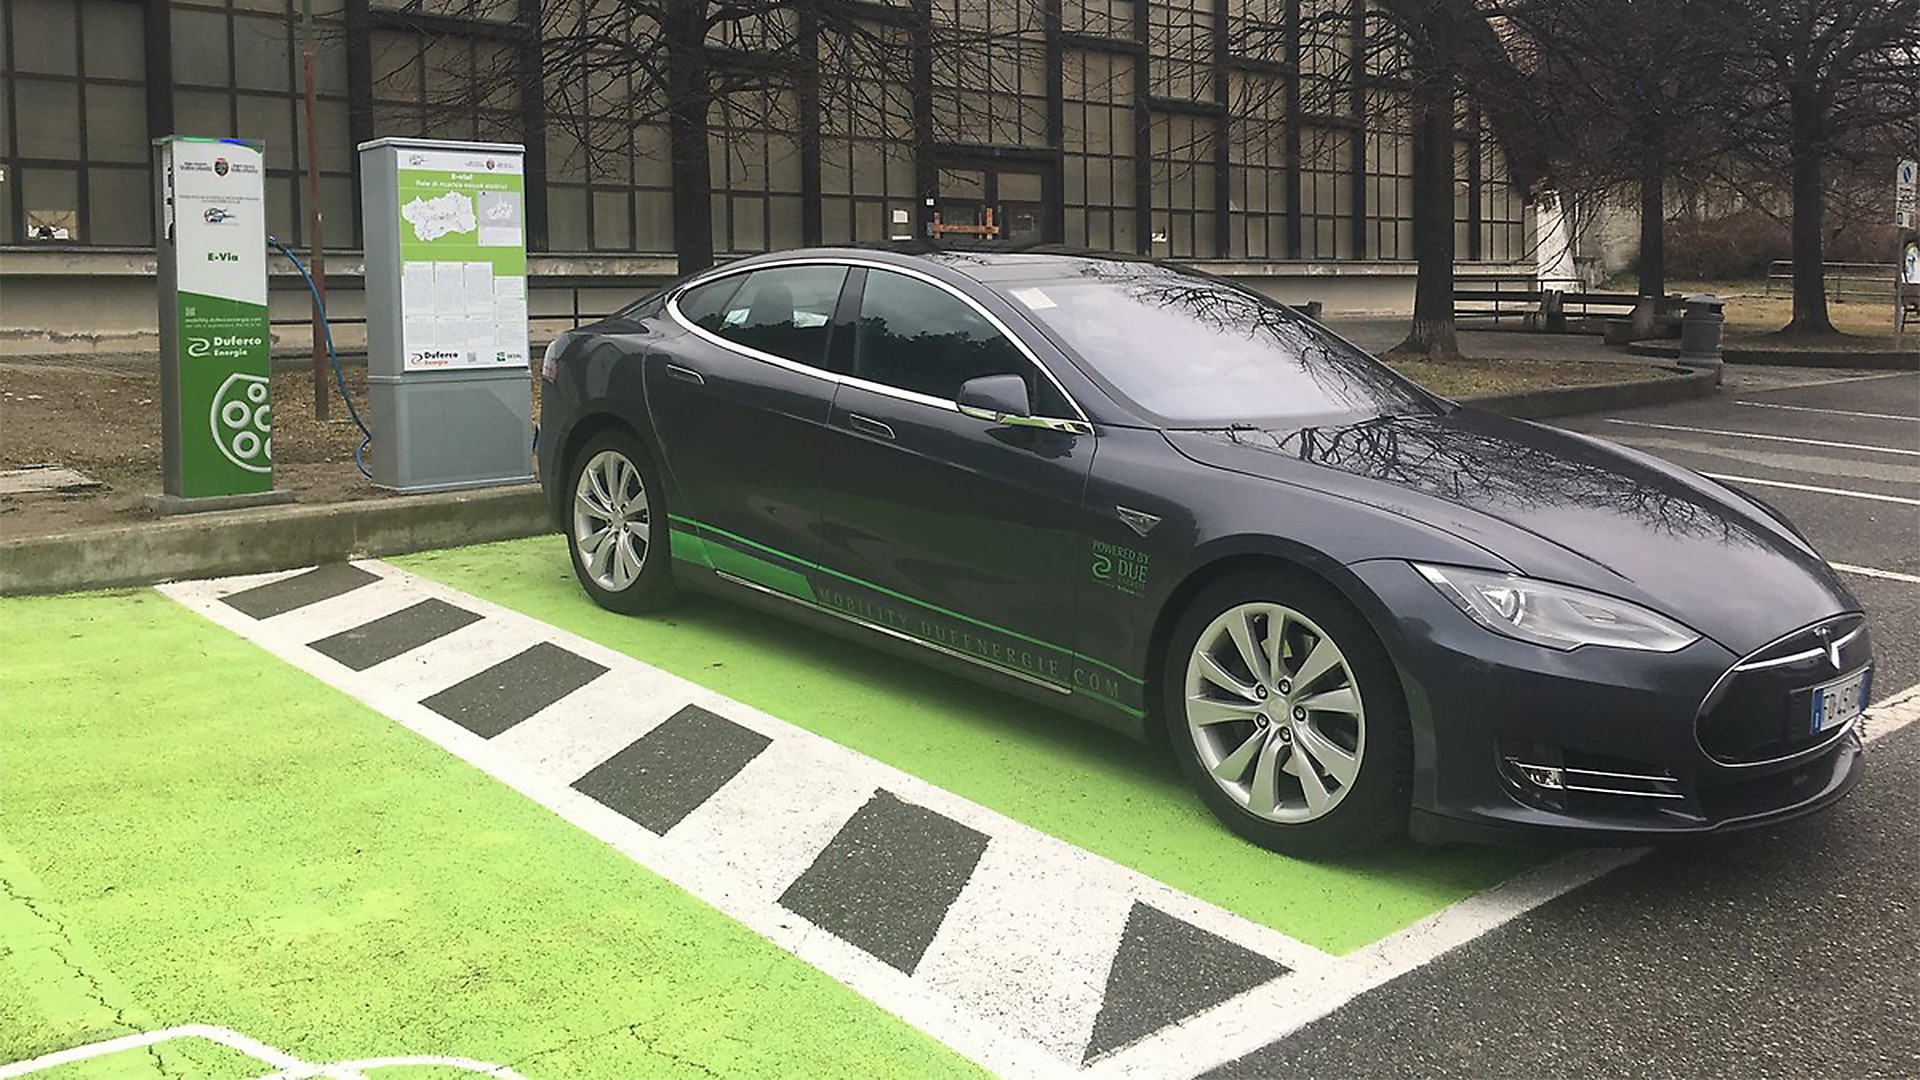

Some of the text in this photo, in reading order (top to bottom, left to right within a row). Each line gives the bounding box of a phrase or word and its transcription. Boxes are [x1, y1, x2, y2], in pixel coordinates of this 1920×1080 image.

[207, 252, 239, 262] E-Via
[213, 335, 262, 346] Duferco
[213, 348, 248, 358] Energia
[423, 351, 459, 360] Duferco
[1092, 540, 1136, 561] POWERED
[1118, 559, 1148, 584] DUE
